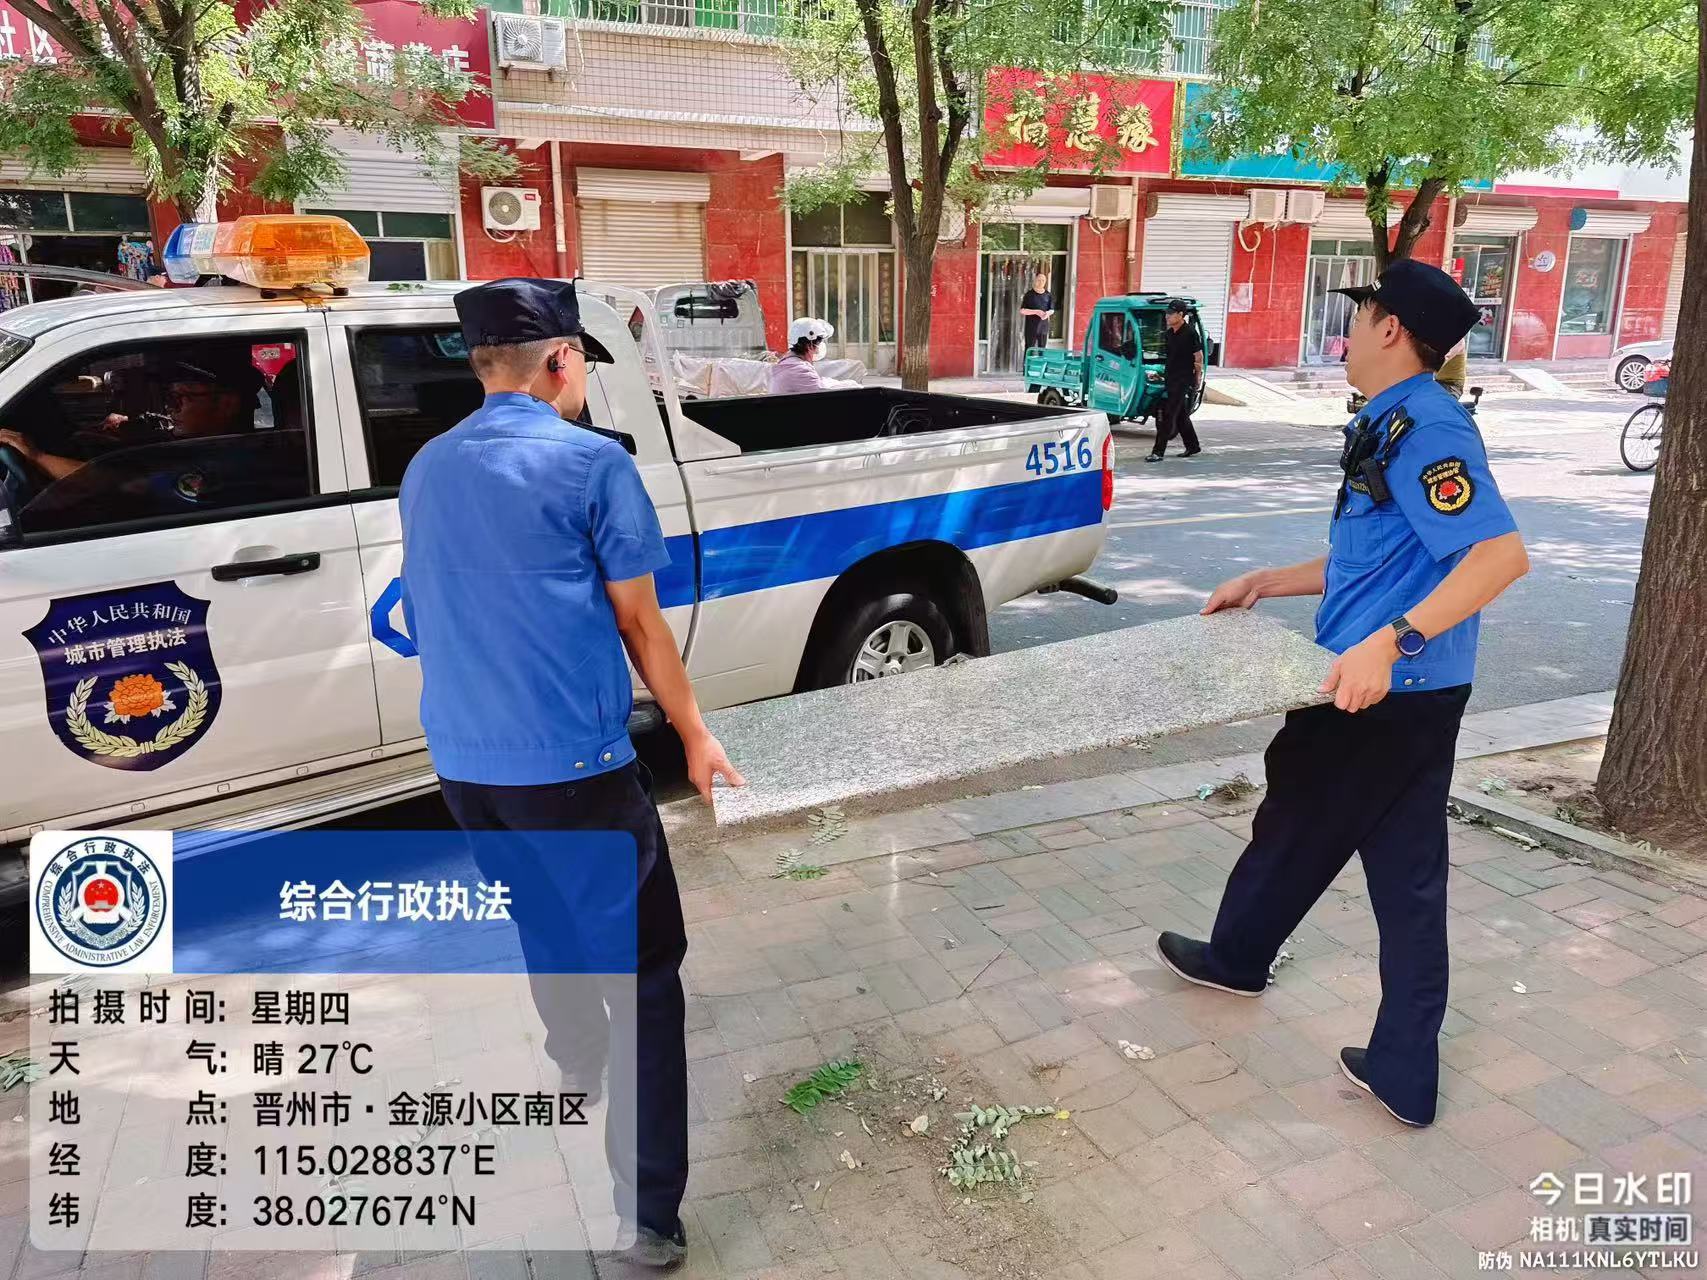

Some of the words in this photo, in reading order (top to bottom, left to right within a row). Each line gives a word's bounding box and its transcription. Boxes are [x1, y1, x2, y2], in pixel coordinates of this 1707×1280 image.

[1026, 437, 1093, 476] 4516
[48, 602, 192, 646] 中华人民共和国
[64, 626, 188, 666] 城市管理执法
